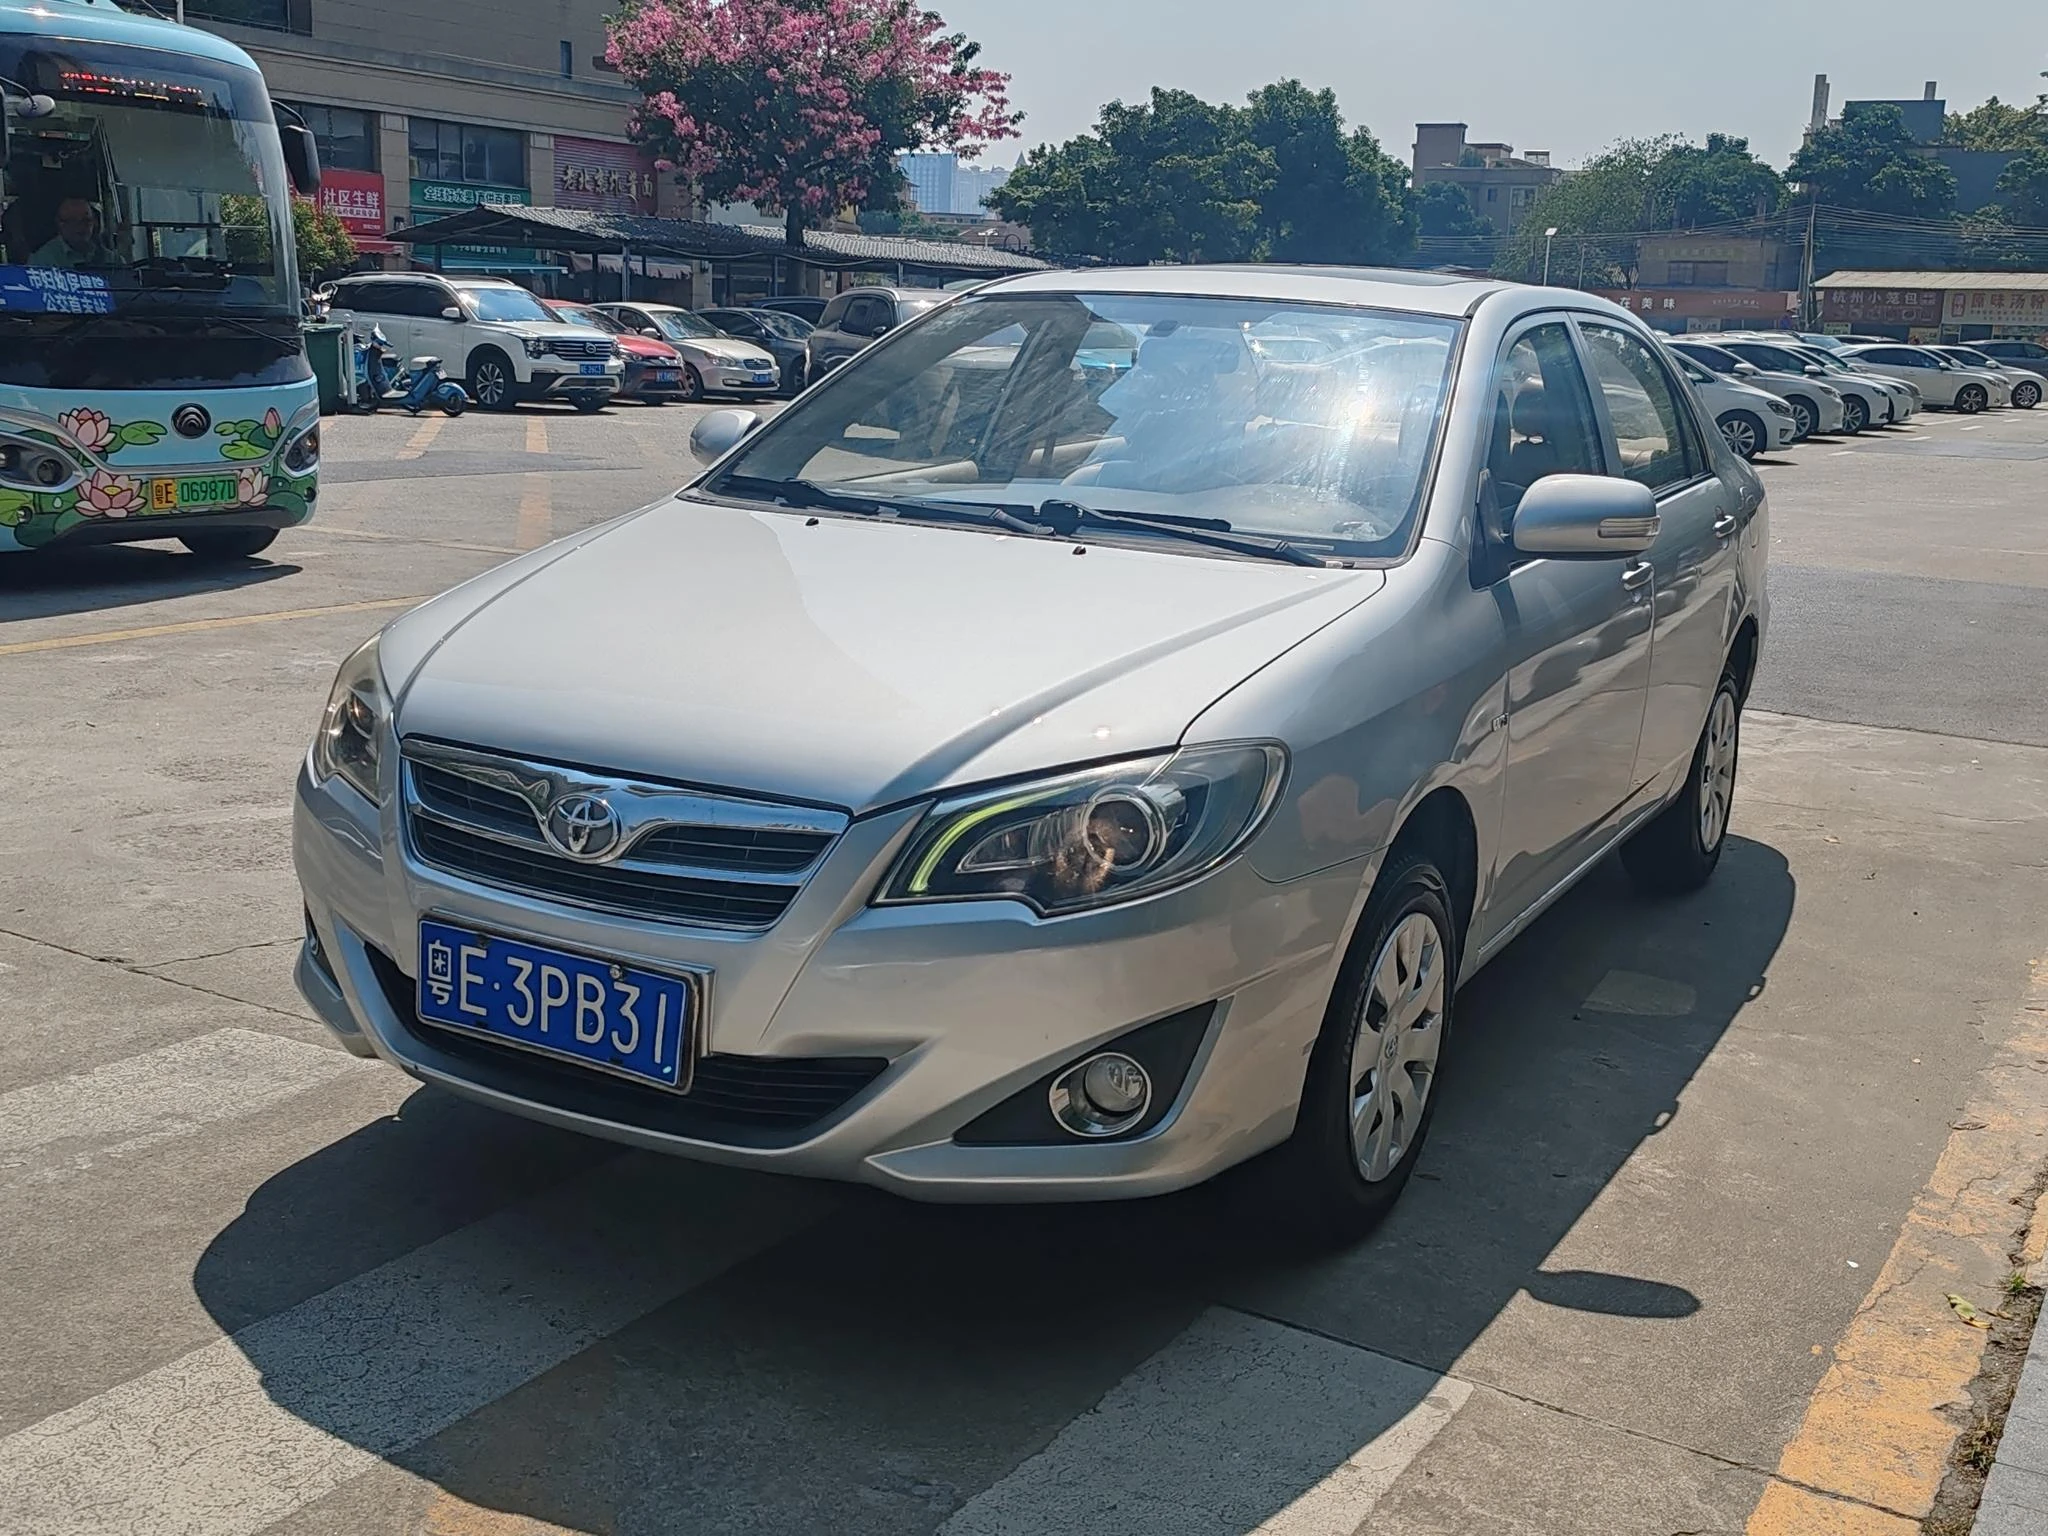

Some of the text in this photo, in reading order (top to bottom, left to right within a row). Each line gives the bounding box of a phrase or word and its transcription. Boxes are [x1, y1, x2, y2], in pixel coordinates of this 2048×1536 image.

[323, 188, 380, 210] 社区生鲜
[423, 185, 475, 204] 全球好水果
[1604, 297, 1676, 310] 在美味
[1832, 290, 1919, 305] 杭州小笼包
[1971, 292, 2045, 310] 原味汤粉
